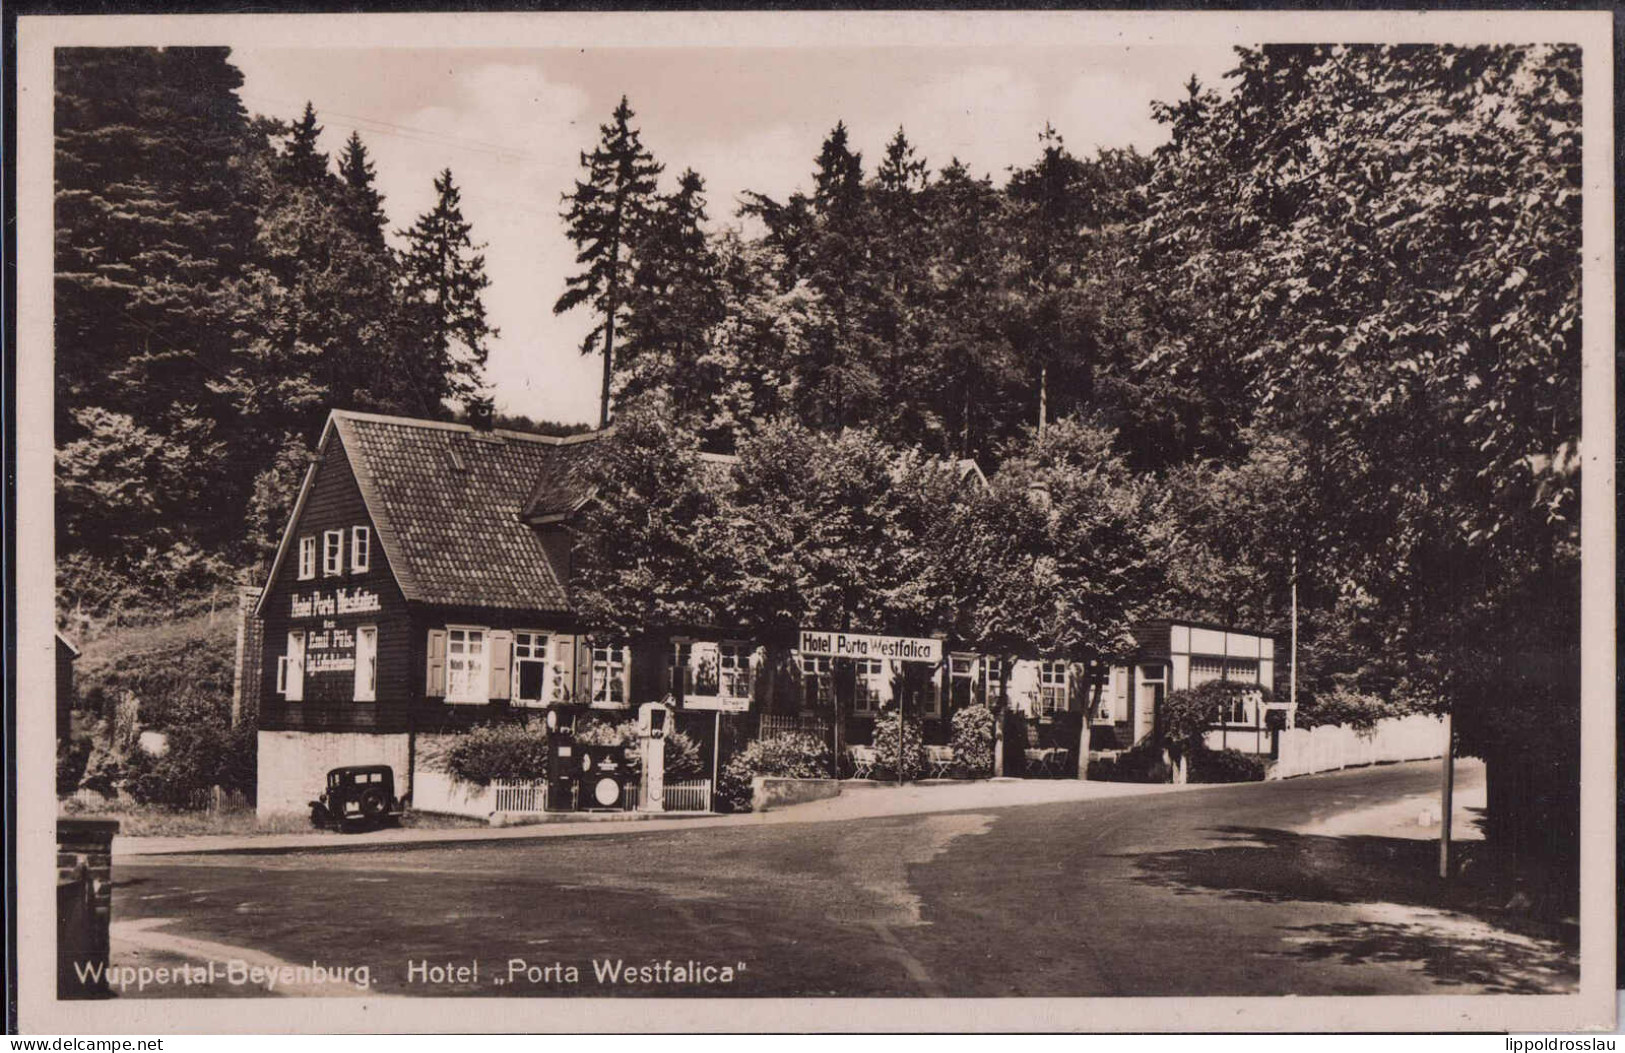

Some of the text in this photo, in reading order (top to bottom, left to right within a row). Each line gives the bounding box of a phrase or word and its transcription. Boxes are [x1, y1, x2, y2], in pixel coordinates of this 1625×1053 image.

[802, 633, 931, 658] Hotel Porta Westfalica
